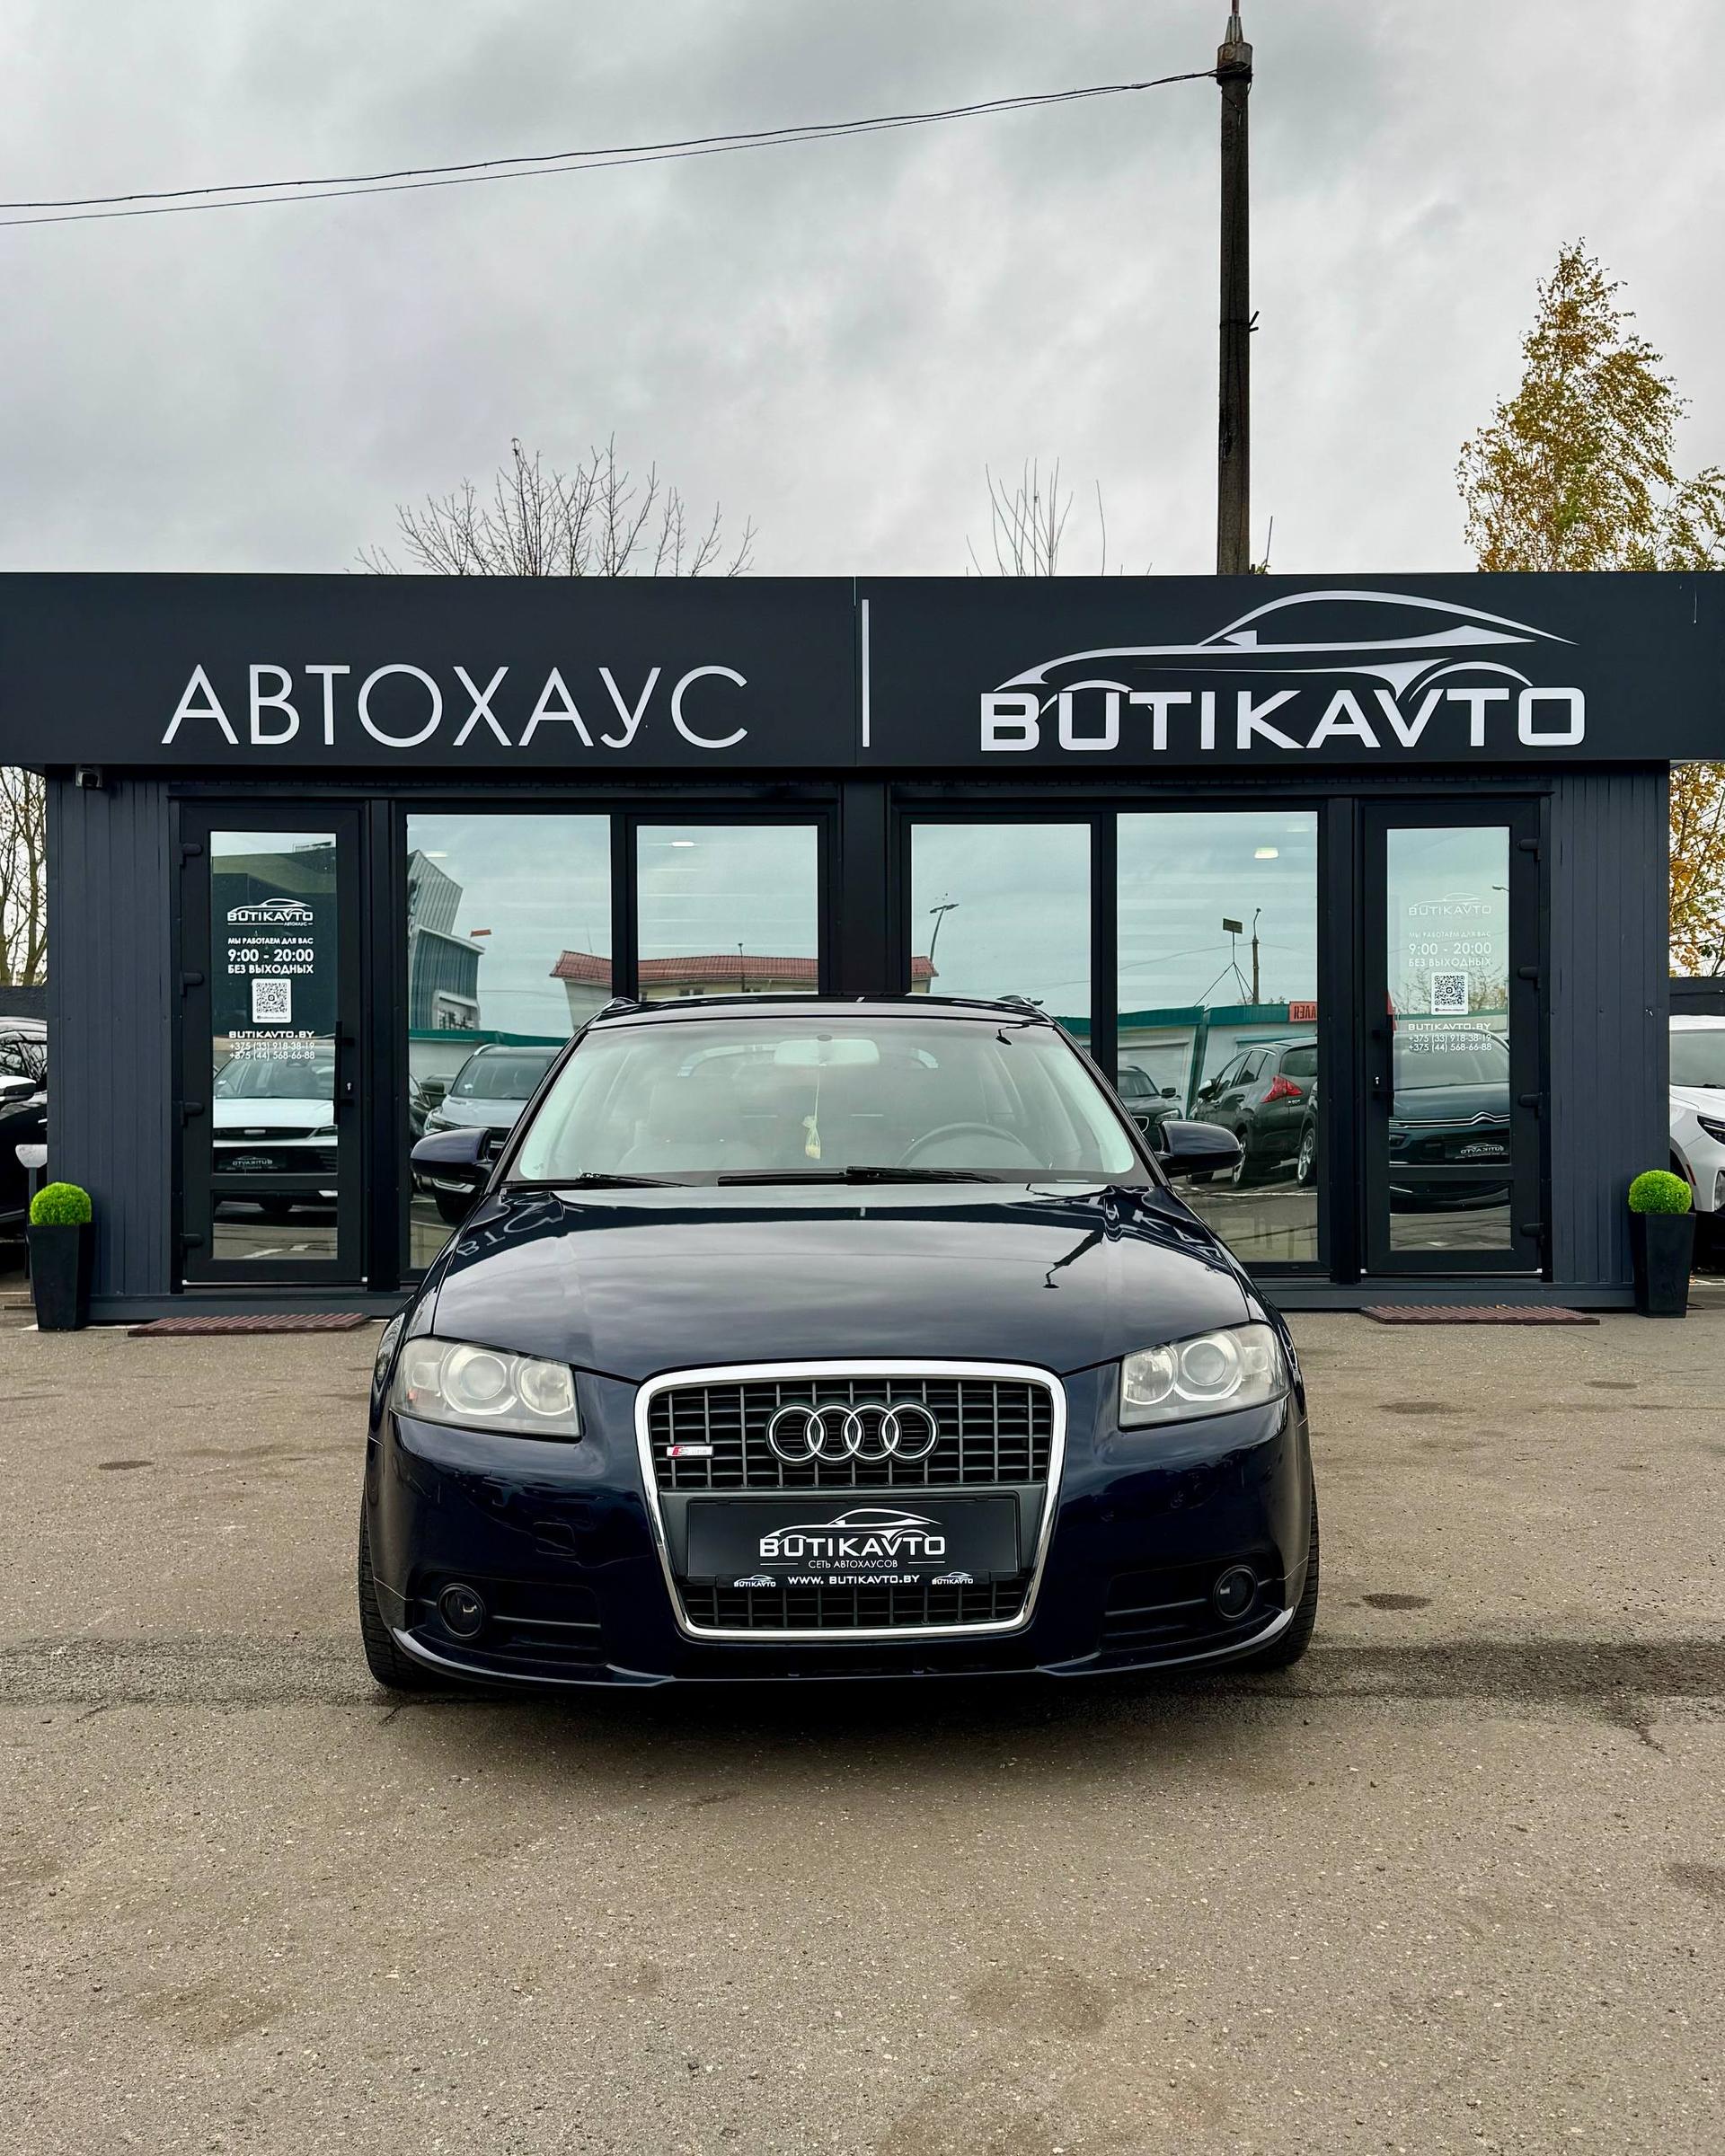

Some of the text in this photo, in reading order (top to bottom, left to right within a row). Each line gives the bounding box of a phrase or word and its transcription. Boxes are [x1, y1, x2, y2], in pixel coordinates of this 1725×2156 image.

[162, 664, 748, 748] АВТОХАУС
[980, 686, 1586, 752] BUTIKAVTO
[1408, 905, 1491, 915] BUTIKAVTO
[227, 912, 314, 922] BUTIKAVTO
[281, 937, 296, 945] ДЛЯ
[1409, 943, 1438, 955] 9:00
[1454, 942, 1491, 955] 20:00
[227, 949, 259, 962] 9:00
[273, 949, 314, 962] 20:00
[1409, 958, 1491, 968] БЕЗ ВЫХОДНЫХ
[227, 964, 314, 975] БЕЗ ВЫХОДНЫХ
[1408, 1022, 1491, 1030] BUTIKAVTO.BY
[228, 1030, 314, 1038] BUTIKAVTO.BY
[1432, 1034, 1447, 1043] (33)
[1450, 1034, 1491, 1042] 918-38-19
[253, 1041, 270, 1051] (33)
[1432, 1043, 1447, 1053] (44)
[1450, 1043, 1491, 1051] 568-66-88
[253, 1051, 270, 1061] (44)
[272, 1051, 314, 1059] 568-66-88
[759, 1536, 946, 1557] BUTIKAVTO
[809, 1560, 898, 1568] СЕТЬ АВТОХАУСОВ
[787, 1574, 920, 1585] WWW. BUTIKAVTO.BY
